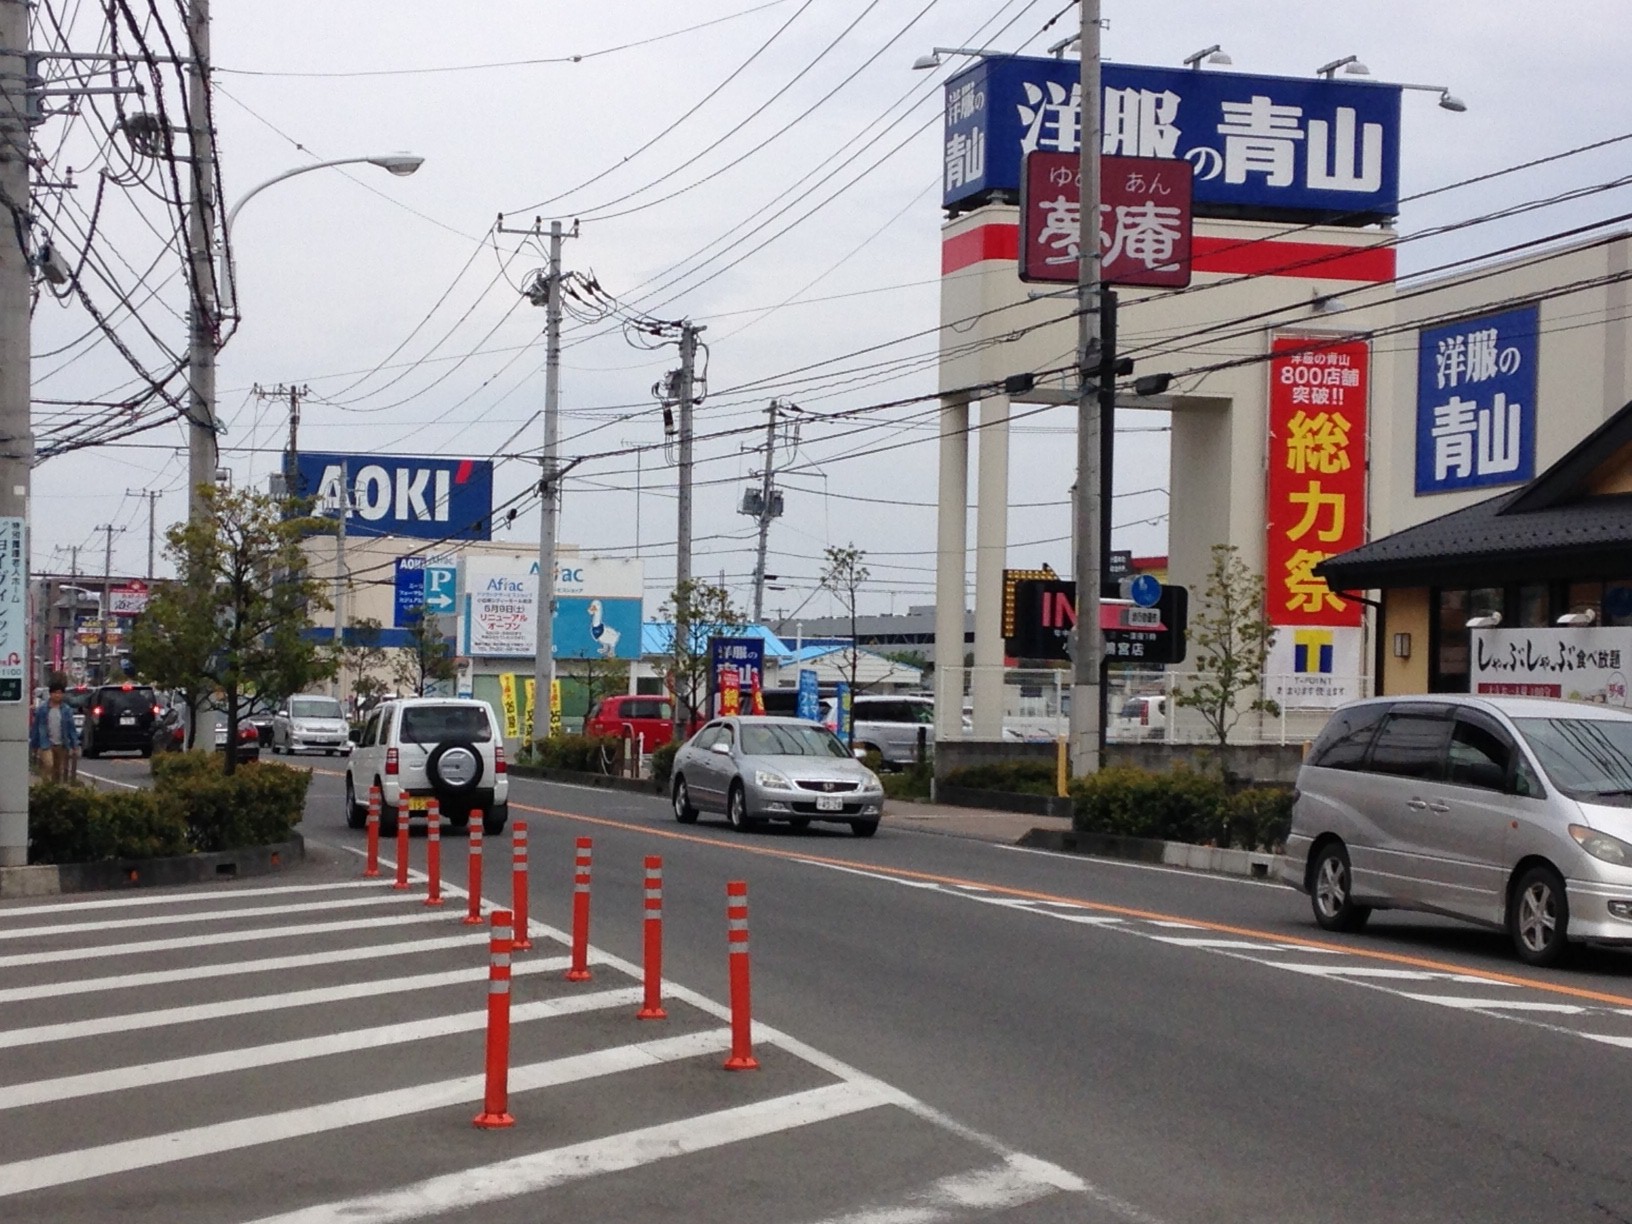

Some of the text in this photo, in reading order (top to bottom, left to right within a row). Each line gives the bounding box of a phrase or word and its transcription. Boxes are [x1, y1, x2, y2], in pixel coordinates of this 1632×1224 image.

[947, 81, 985, 126] 洋服の
[944, 126, 985, 192] 青山
[1017, 81, 1382, 193] 洋服の青山
[1125, 171, 1172, 196] あん
[1038, 195, 1182, 273] 夢庵
[1281, 366, 1360, 387] 800店舗
[1436, 328, 1521, 391] 洋服の
[1431, 392, 1521, 482] 青山
[311, 464, 451, 522] AOKI
[1284, 410, 1351, 614] 総力祭
[430, 570, 452, 592] P
[487, 578, 524, 592] Aflac
[718, 645, 758, 660] 洋服の
[1477, 636, 1622, 673] しゃぶしゃぶ食べ放題
